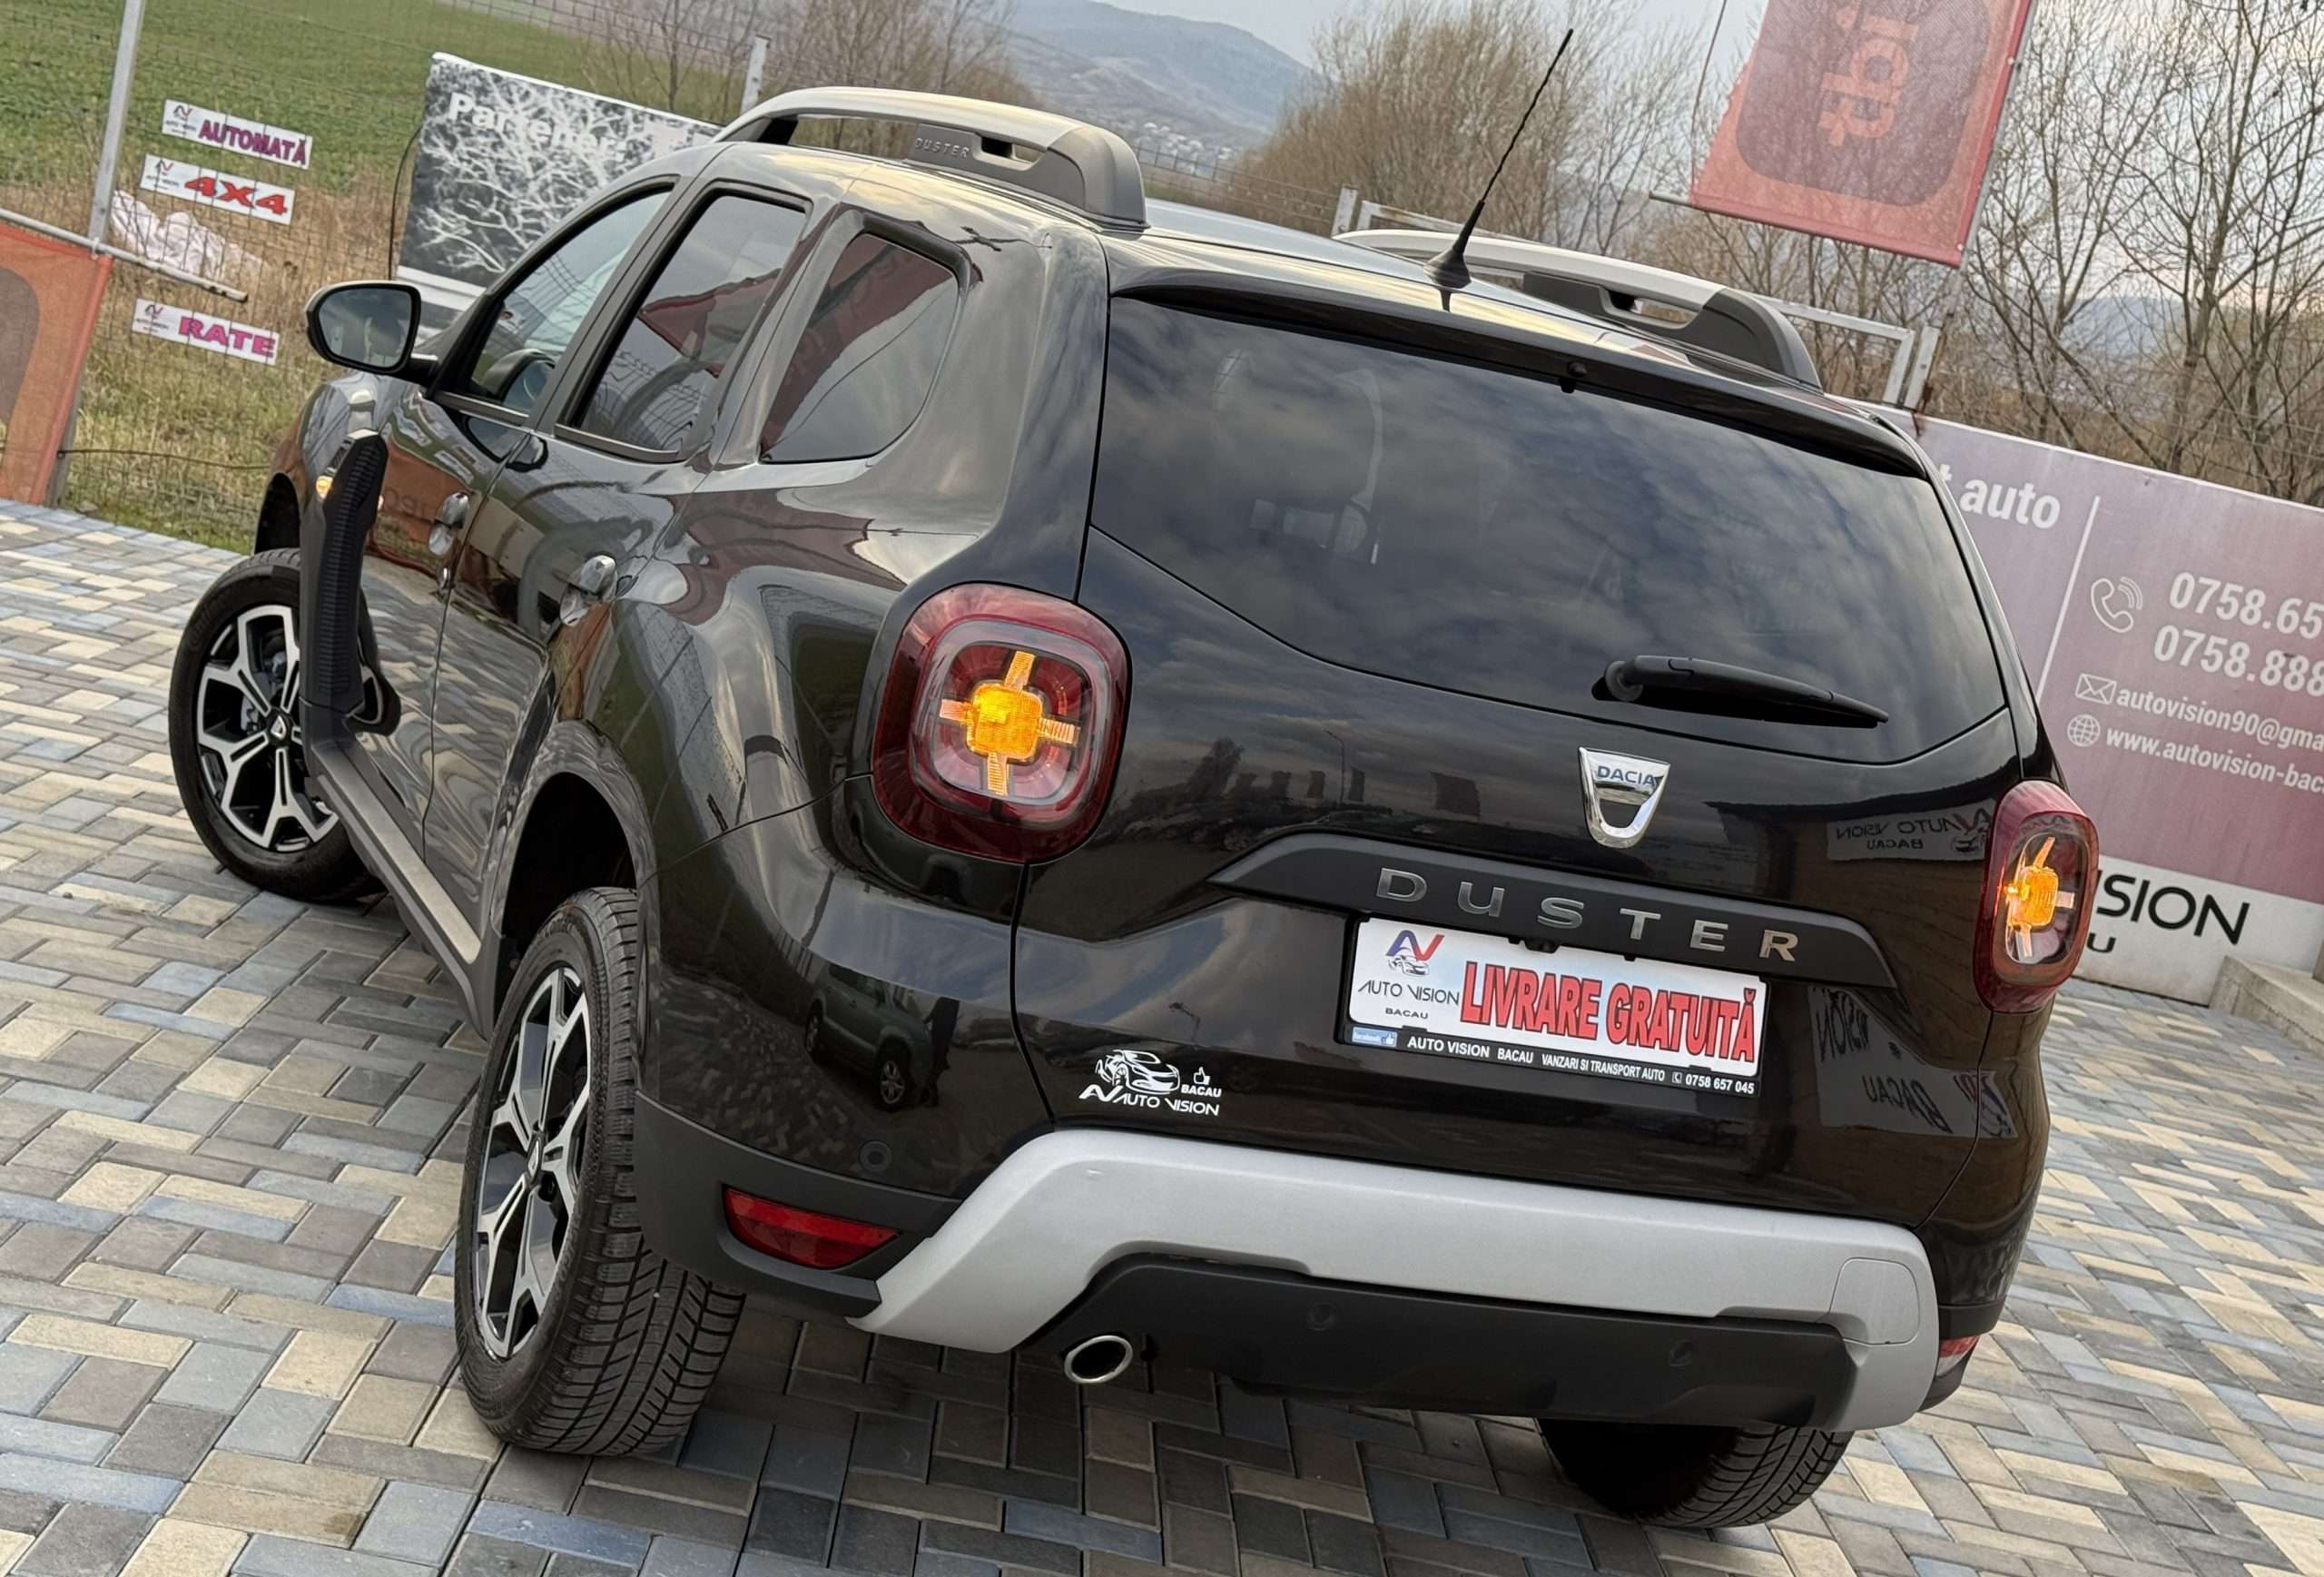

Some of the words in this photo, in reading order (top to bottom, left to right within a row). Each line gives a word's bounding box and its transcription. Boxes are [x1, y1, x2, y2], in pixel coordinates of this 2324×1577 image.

[1818, 4, 1918, 146] tbi
[198, 119, 307, 165] AUTOMATĂ
[914, 137, 970, 158] DUSTER
[179, 315, 276, 358] RATE
[1960, 478, 2061, 529] auto
[2169, 572, 2324, 639] 0758.65
[1597, 765, 1657, 787] DACIA
[2106, 726, 2324, 794] www.autovision-bac
[1375, 867, 1799, 962] DUSTER
[2097, 870, 2250, 945] SION
[1358, 980, 1403, 998] AUTO
[1406, 984, 1460, 1006] VISION
[1385, 1007, 1429, 1020] BACAU
[1460, 961, 1602, 1040] LIVRARE
[1606, 982, 1757, 1063] GRATUITĂ
[1407, 1036, 1444, 1051] AUTO
[1447, 1040, 1490, 1058] VISION
[1497, 1048, 1533, 1063] BACAU
[1541, 1053, 1579, 1069] VANZARI
[1580, 1060, 1589, 1071] SI
[1590, 1060, 1642, 1078] TRANSPORT
[1641, 1067, 1665, 1082] AUTO
[1685, 1075, 1711, 1089] 0758
[1713, 1078, 1734, 1090] 657
[1735, 1080, 1755, 1095] 045
[1113, 1093, 1160, 1109] AUTO
[1164, 1097, 1220, 1116] VISION
[1180, 1084, 1222, 1098] BACAU
